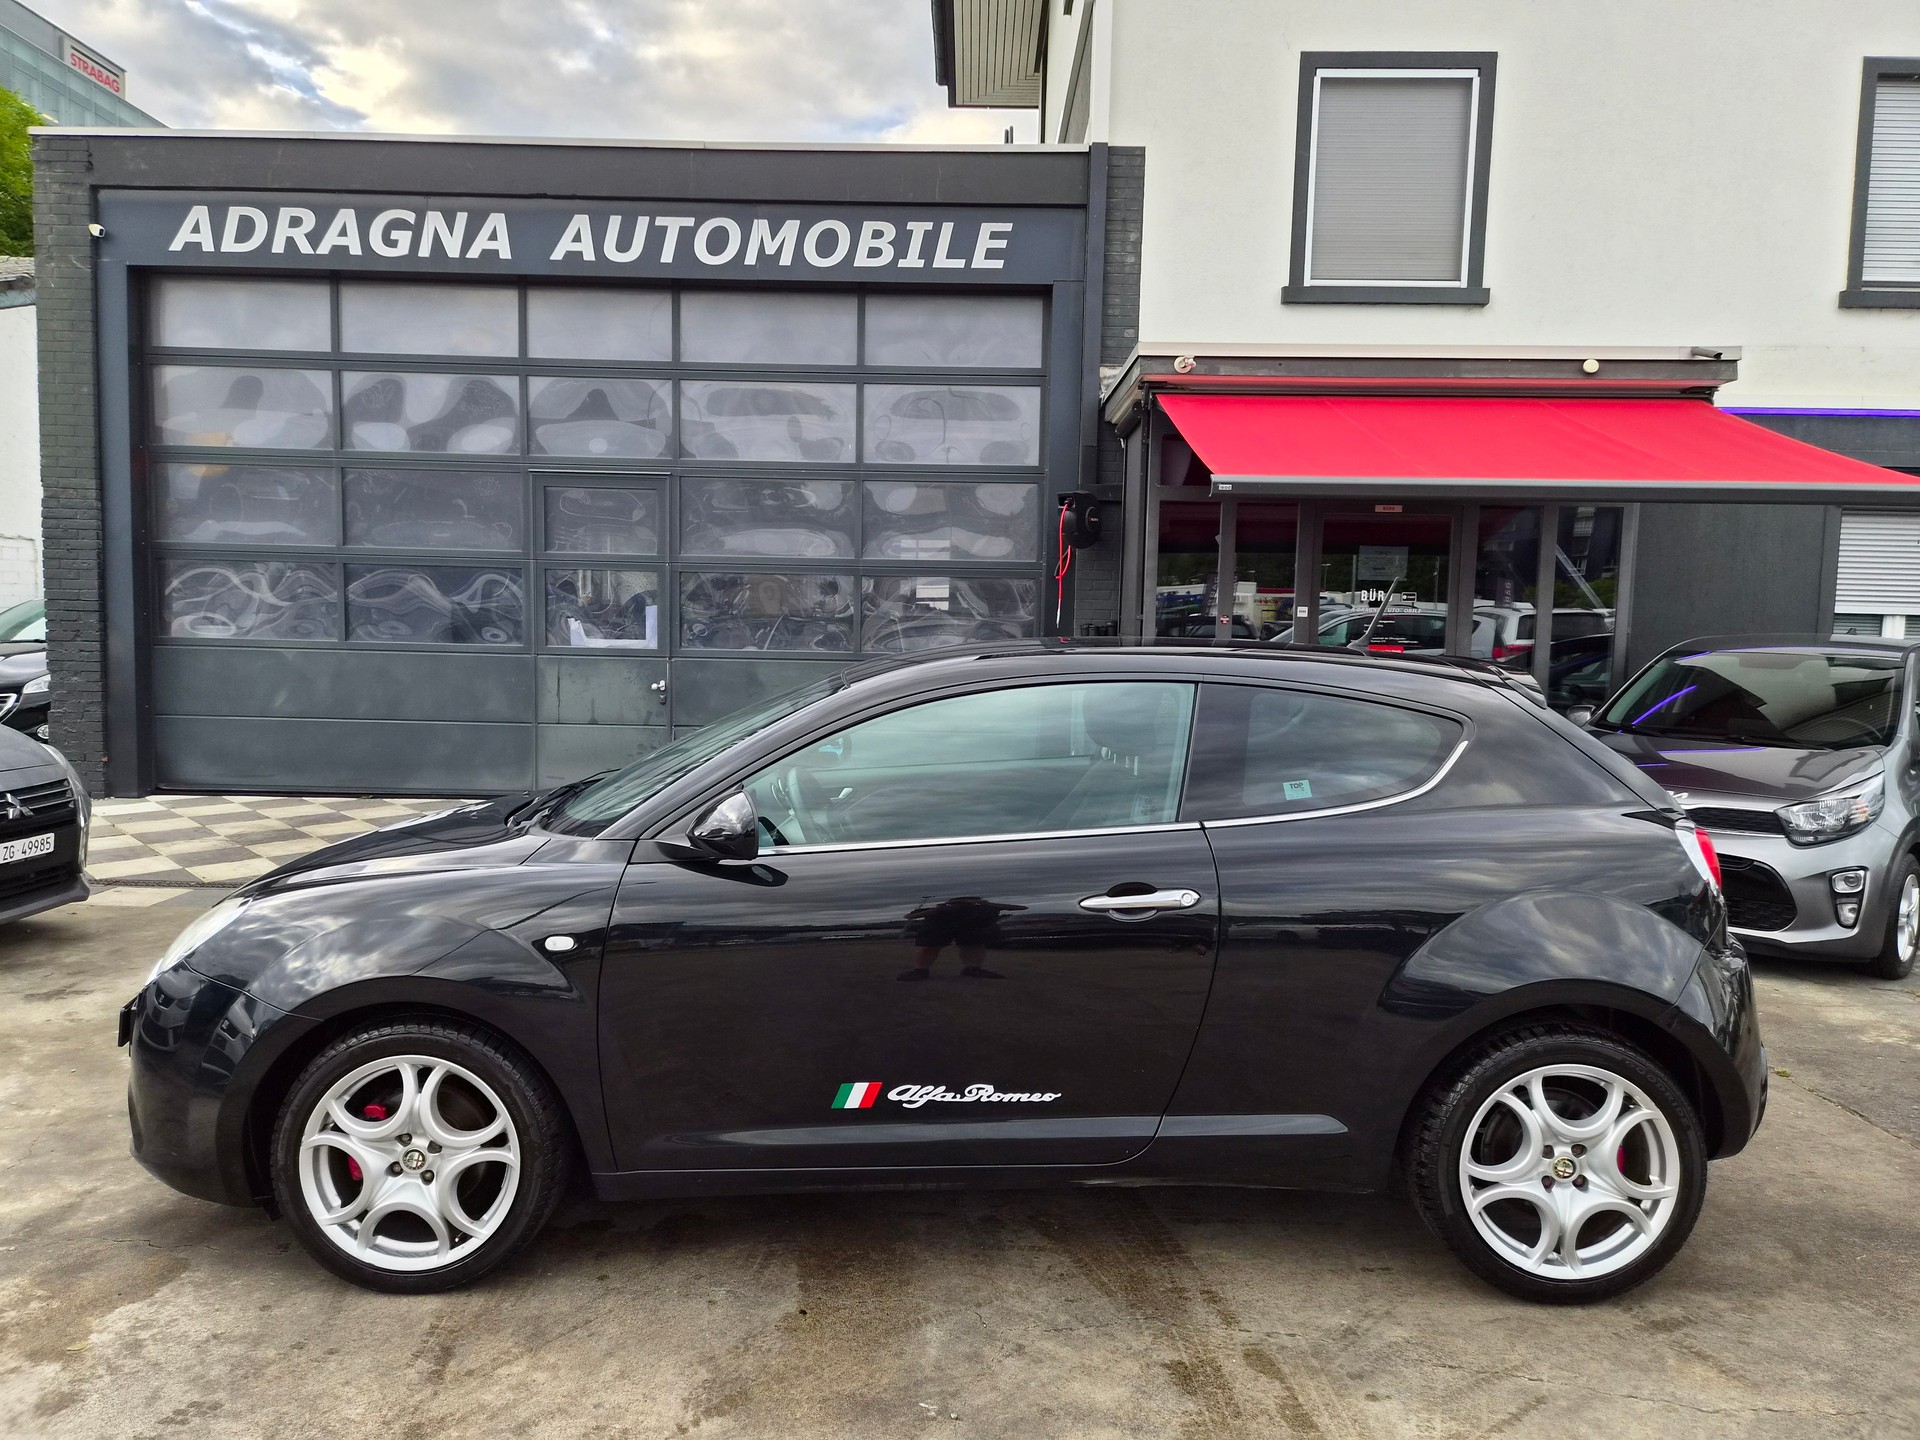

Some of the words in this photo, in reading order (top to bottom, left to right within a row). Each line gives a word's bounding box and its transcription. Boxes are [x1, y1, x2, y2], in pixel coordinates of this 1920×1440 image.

[70, 52, 121, 93] STRABAG
[168, 205, 513, 260] ADRAGNA
[549, 214, 1015, 269] AUTOMOBILE
[1289, 782, 1304, 790] TOP
[3, 845, 15, 861] ZG
[21, 836, 52, 856] 49985
[887, 1084, 961, 1109] Alfa
[964, 1083, 1062, 1103] Romeo
